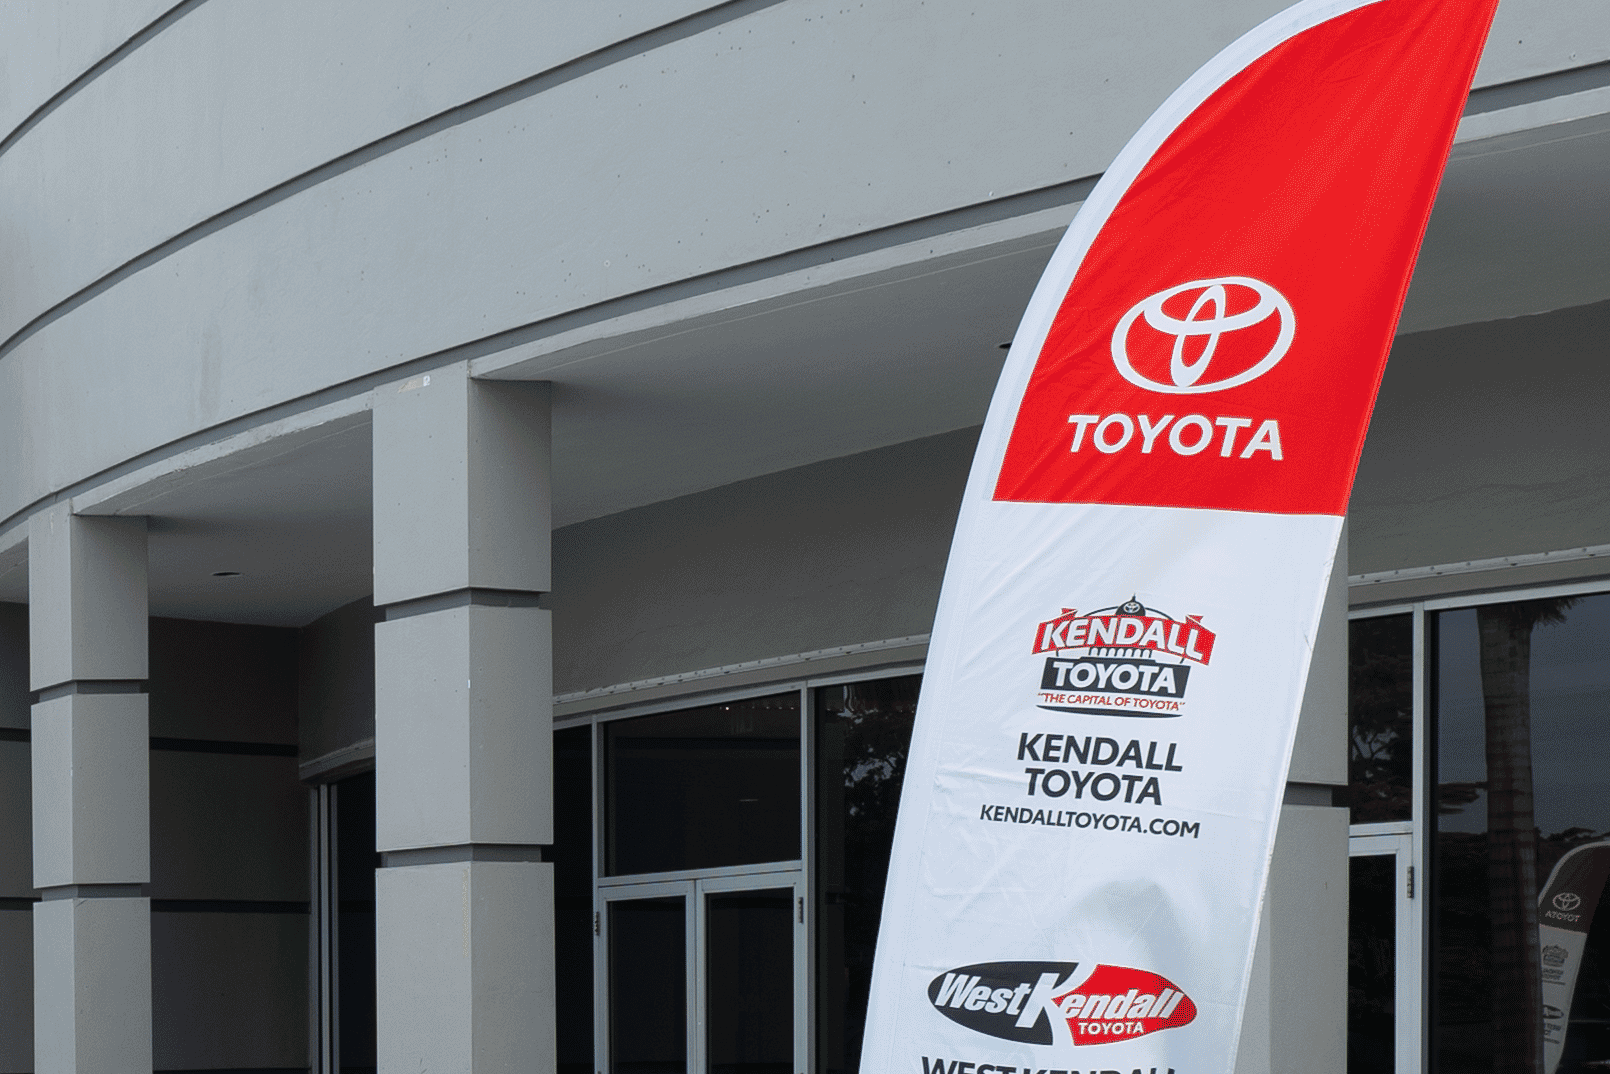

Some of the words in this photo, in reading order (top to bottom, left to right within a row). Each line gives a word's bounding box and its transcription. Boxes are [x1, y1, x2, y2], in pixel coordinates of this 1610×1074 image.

[1067, 412, 1284, 461] TOYOTA
[1040, 616, 1205, 661] KENDALL
[1052, 661, 1177, 694] TOYOTA
[1067, 694, 1112, 706] CAPITAL
[1114, 697, 1131, 707] OF
[1016, 732, 1183, 772] KENDALL
[1024, 767, 1162, 806] TOYOTA
[979, 804, 1201, 839] KENDALLTOYOTA.COM
[934, 971, 1032, 1017] West
[1014, 971, 1187, 1029] Kendall
[1078, 1021, 1146, 1036] TOYOTA
